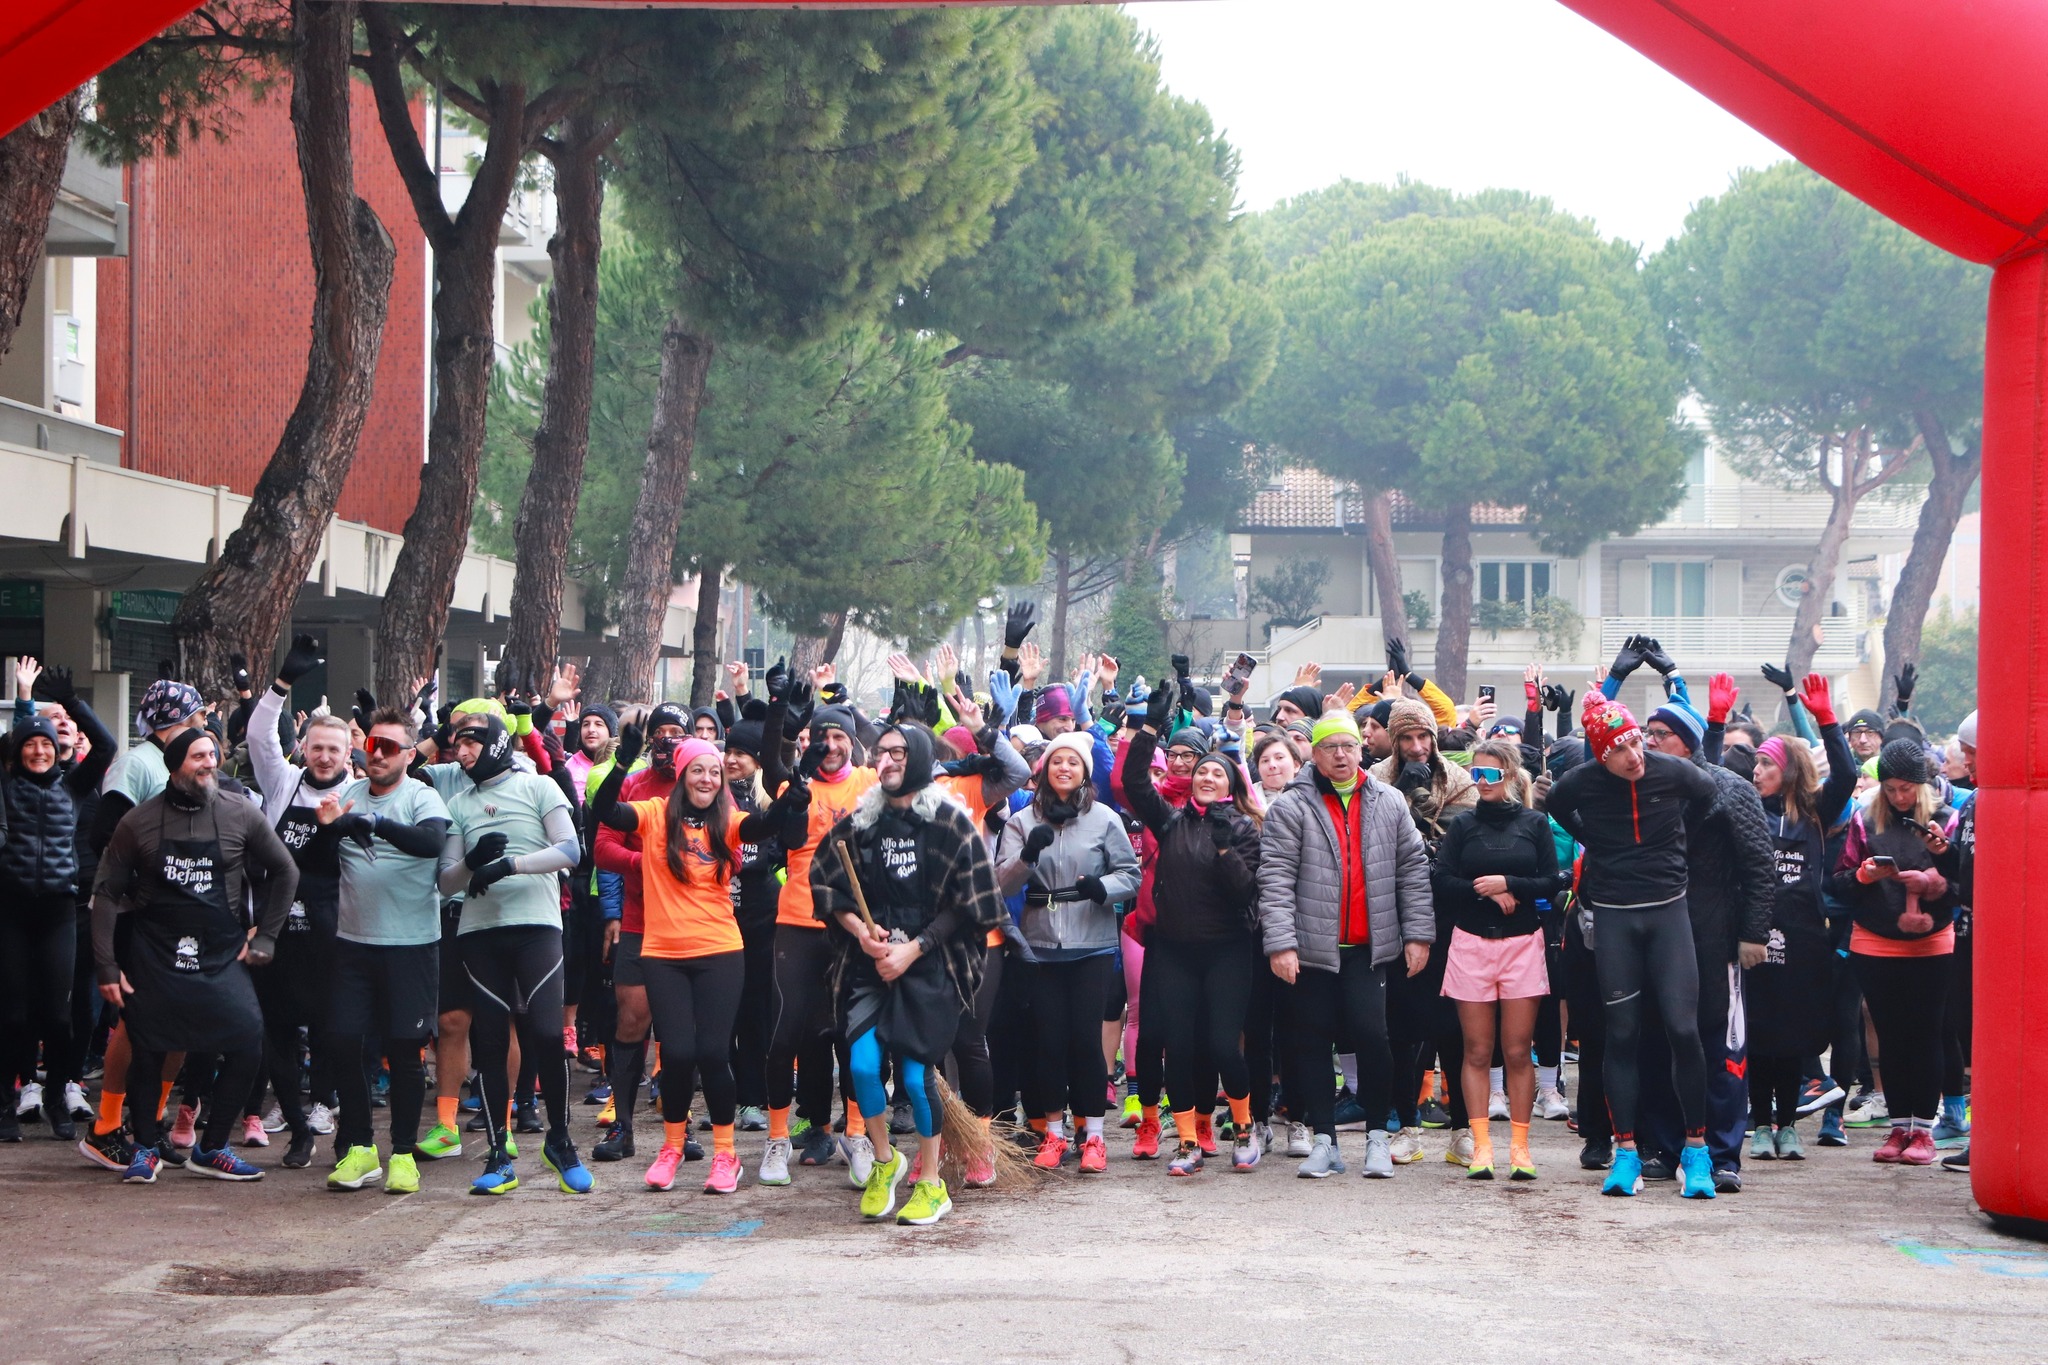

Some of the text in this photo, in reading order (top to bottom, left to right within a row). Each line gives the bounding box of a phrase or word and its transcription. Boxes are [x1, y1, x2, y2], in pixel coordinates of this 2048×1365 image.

[1785, 851, 1804, 861] della
[165, 855, 174, 865] Il
[175, 858, 196, 869] tuffo
[163, 865, 213, 885] Befana
[897, 863, 918, 878] Run
[1782, 873, 1802, 884] Run
[194, 882, 213, 894] Run
[186, 961, 200, 970] Pini
[1772, 956, 1785, 965] Pini
